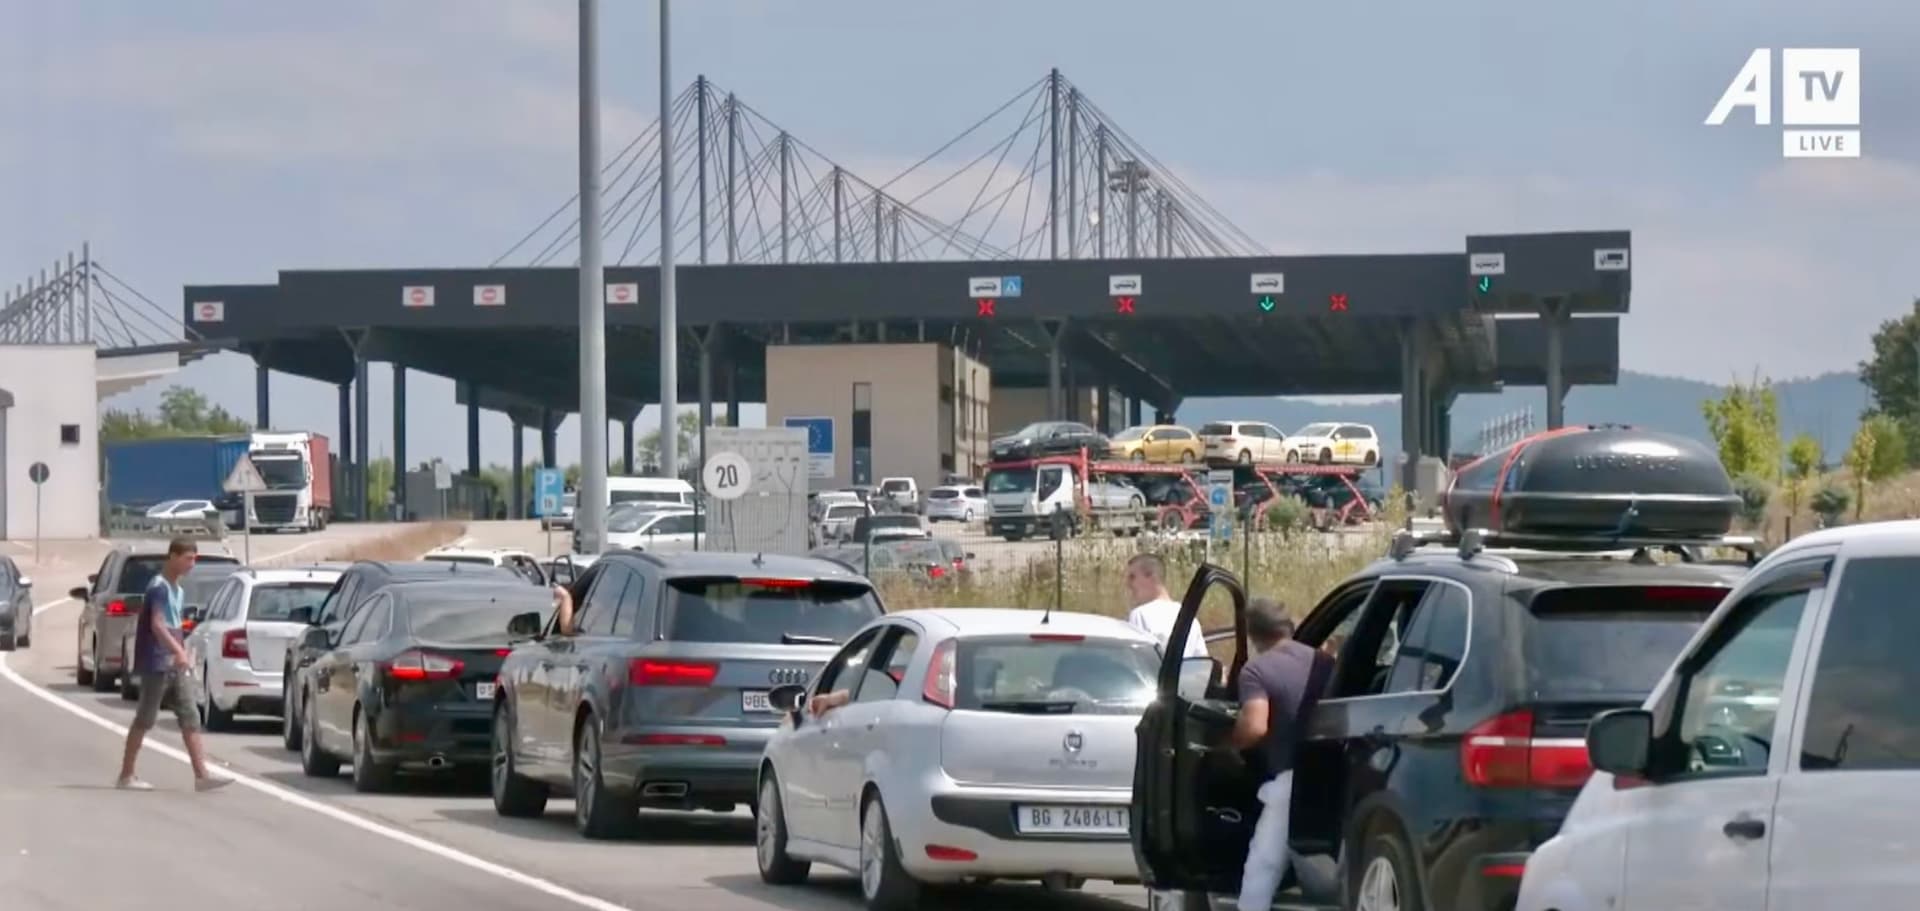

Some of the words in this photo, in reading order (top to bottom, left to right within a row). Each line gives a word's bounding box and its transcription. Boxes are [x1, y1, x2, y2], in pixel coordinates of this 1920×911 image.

[543, 472, 557, 494] P
[715, 463, 739, 489] 20
[752, 694, 769, 708] BE
[1031, 808, 1052, 826] BG
